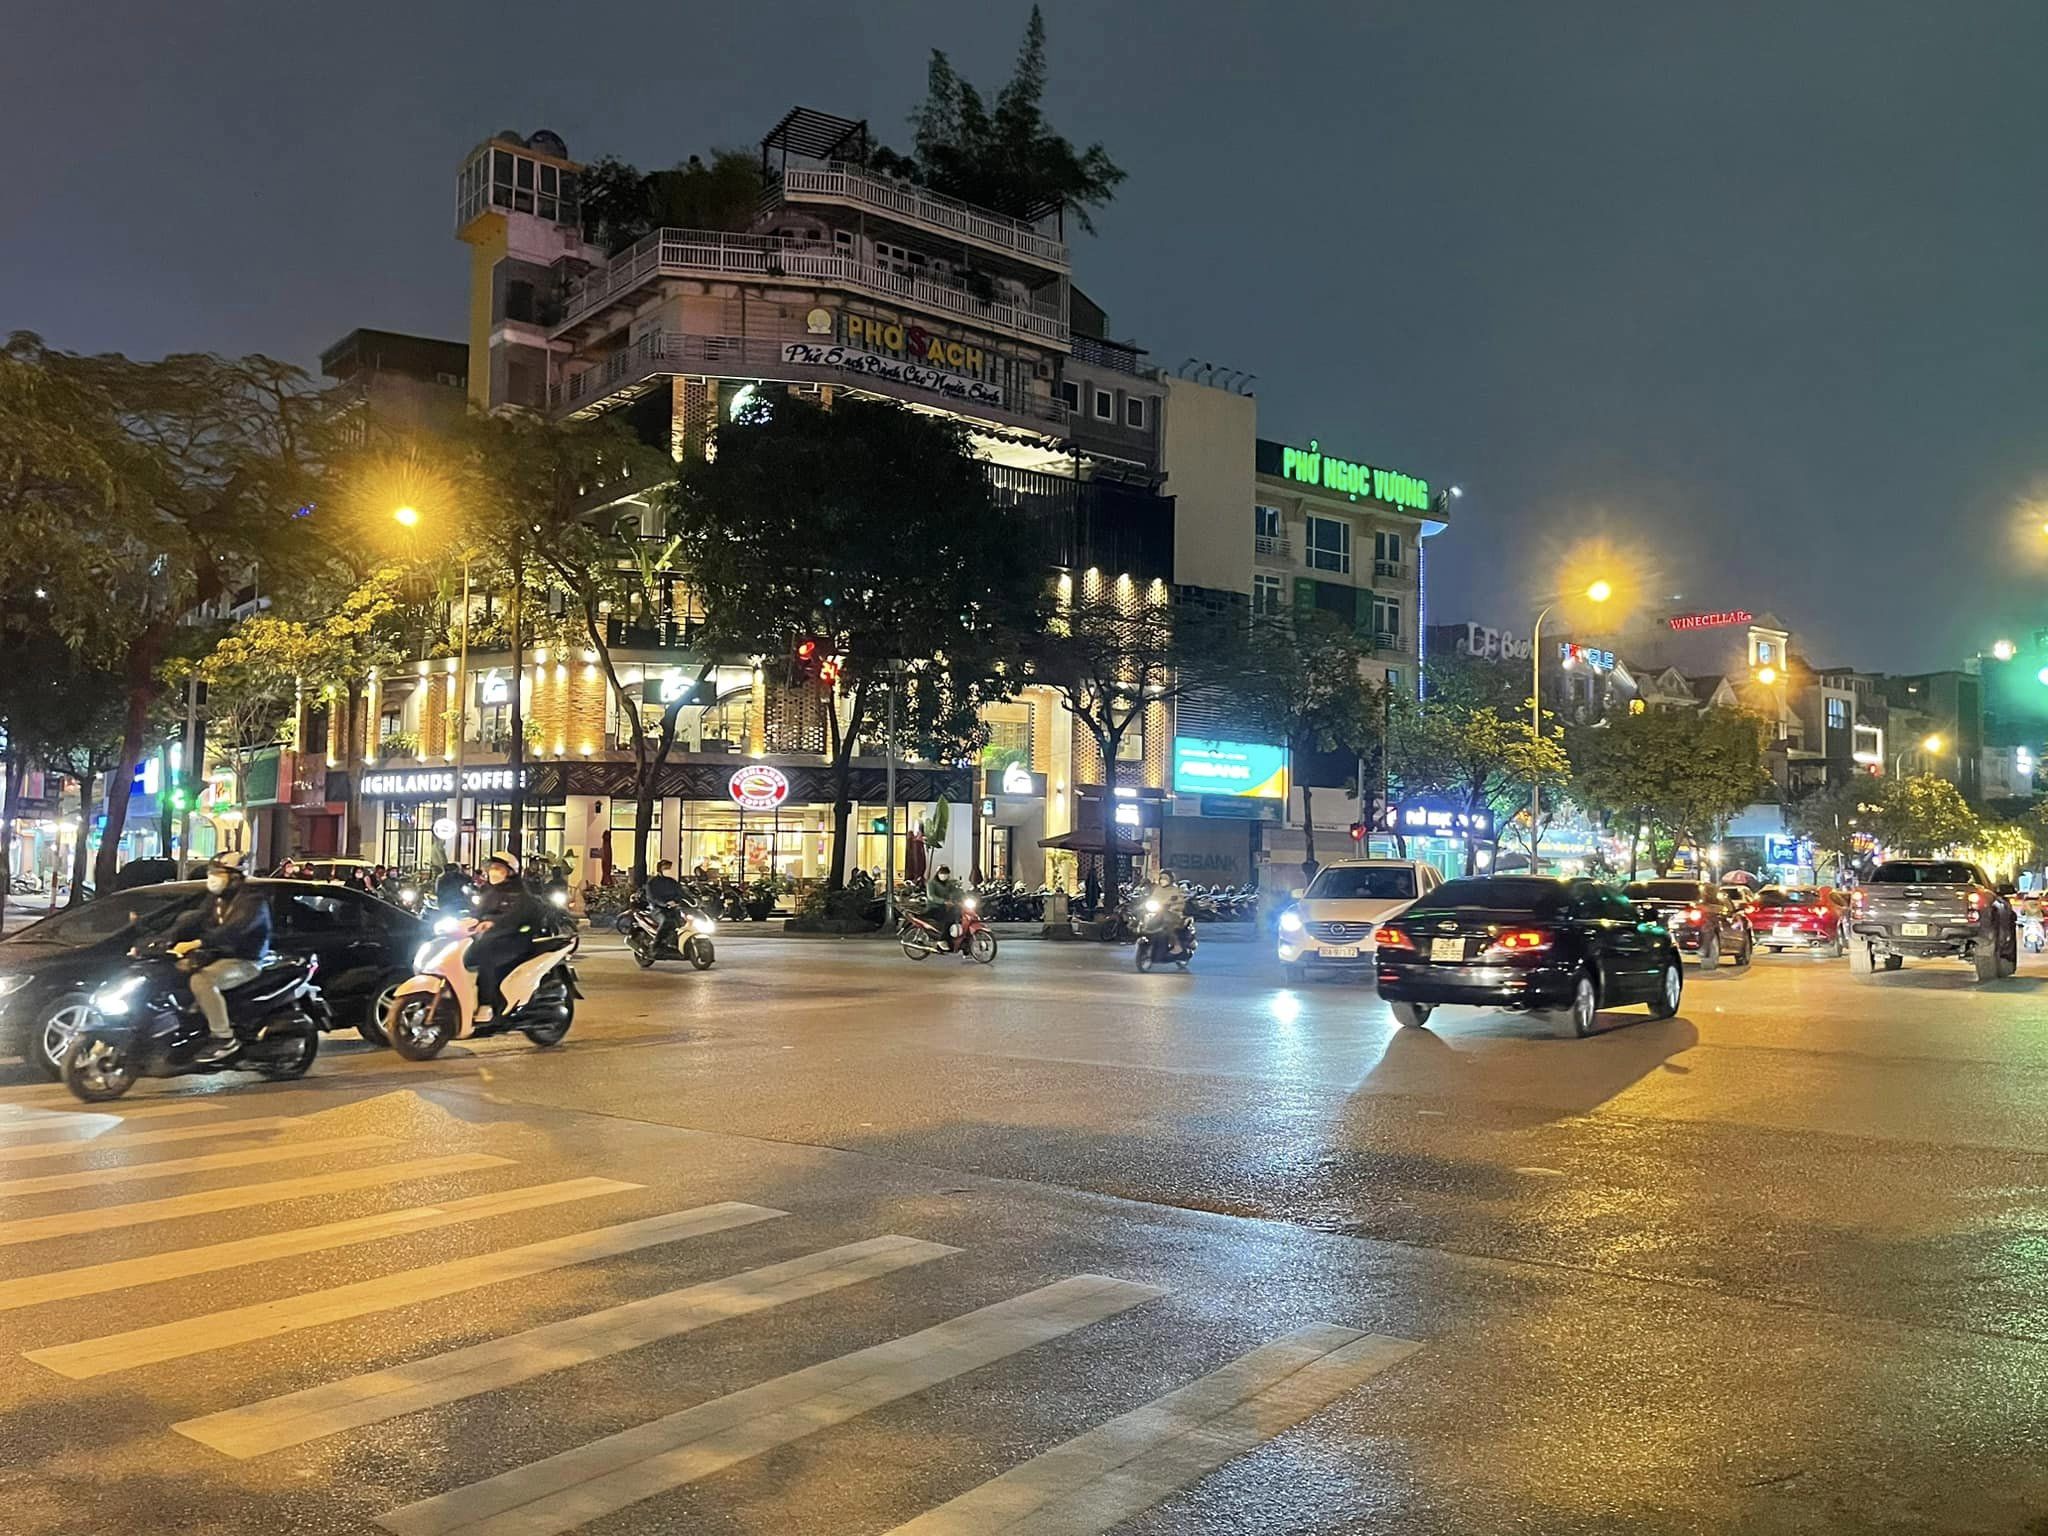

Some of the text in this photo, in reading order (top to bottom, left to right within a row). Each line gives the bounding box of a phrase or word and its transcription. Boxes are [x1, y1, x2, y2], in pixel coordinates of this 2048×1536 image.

[1283, 440, 1428, 512] PHỞ NGỌC VƯỢNG
